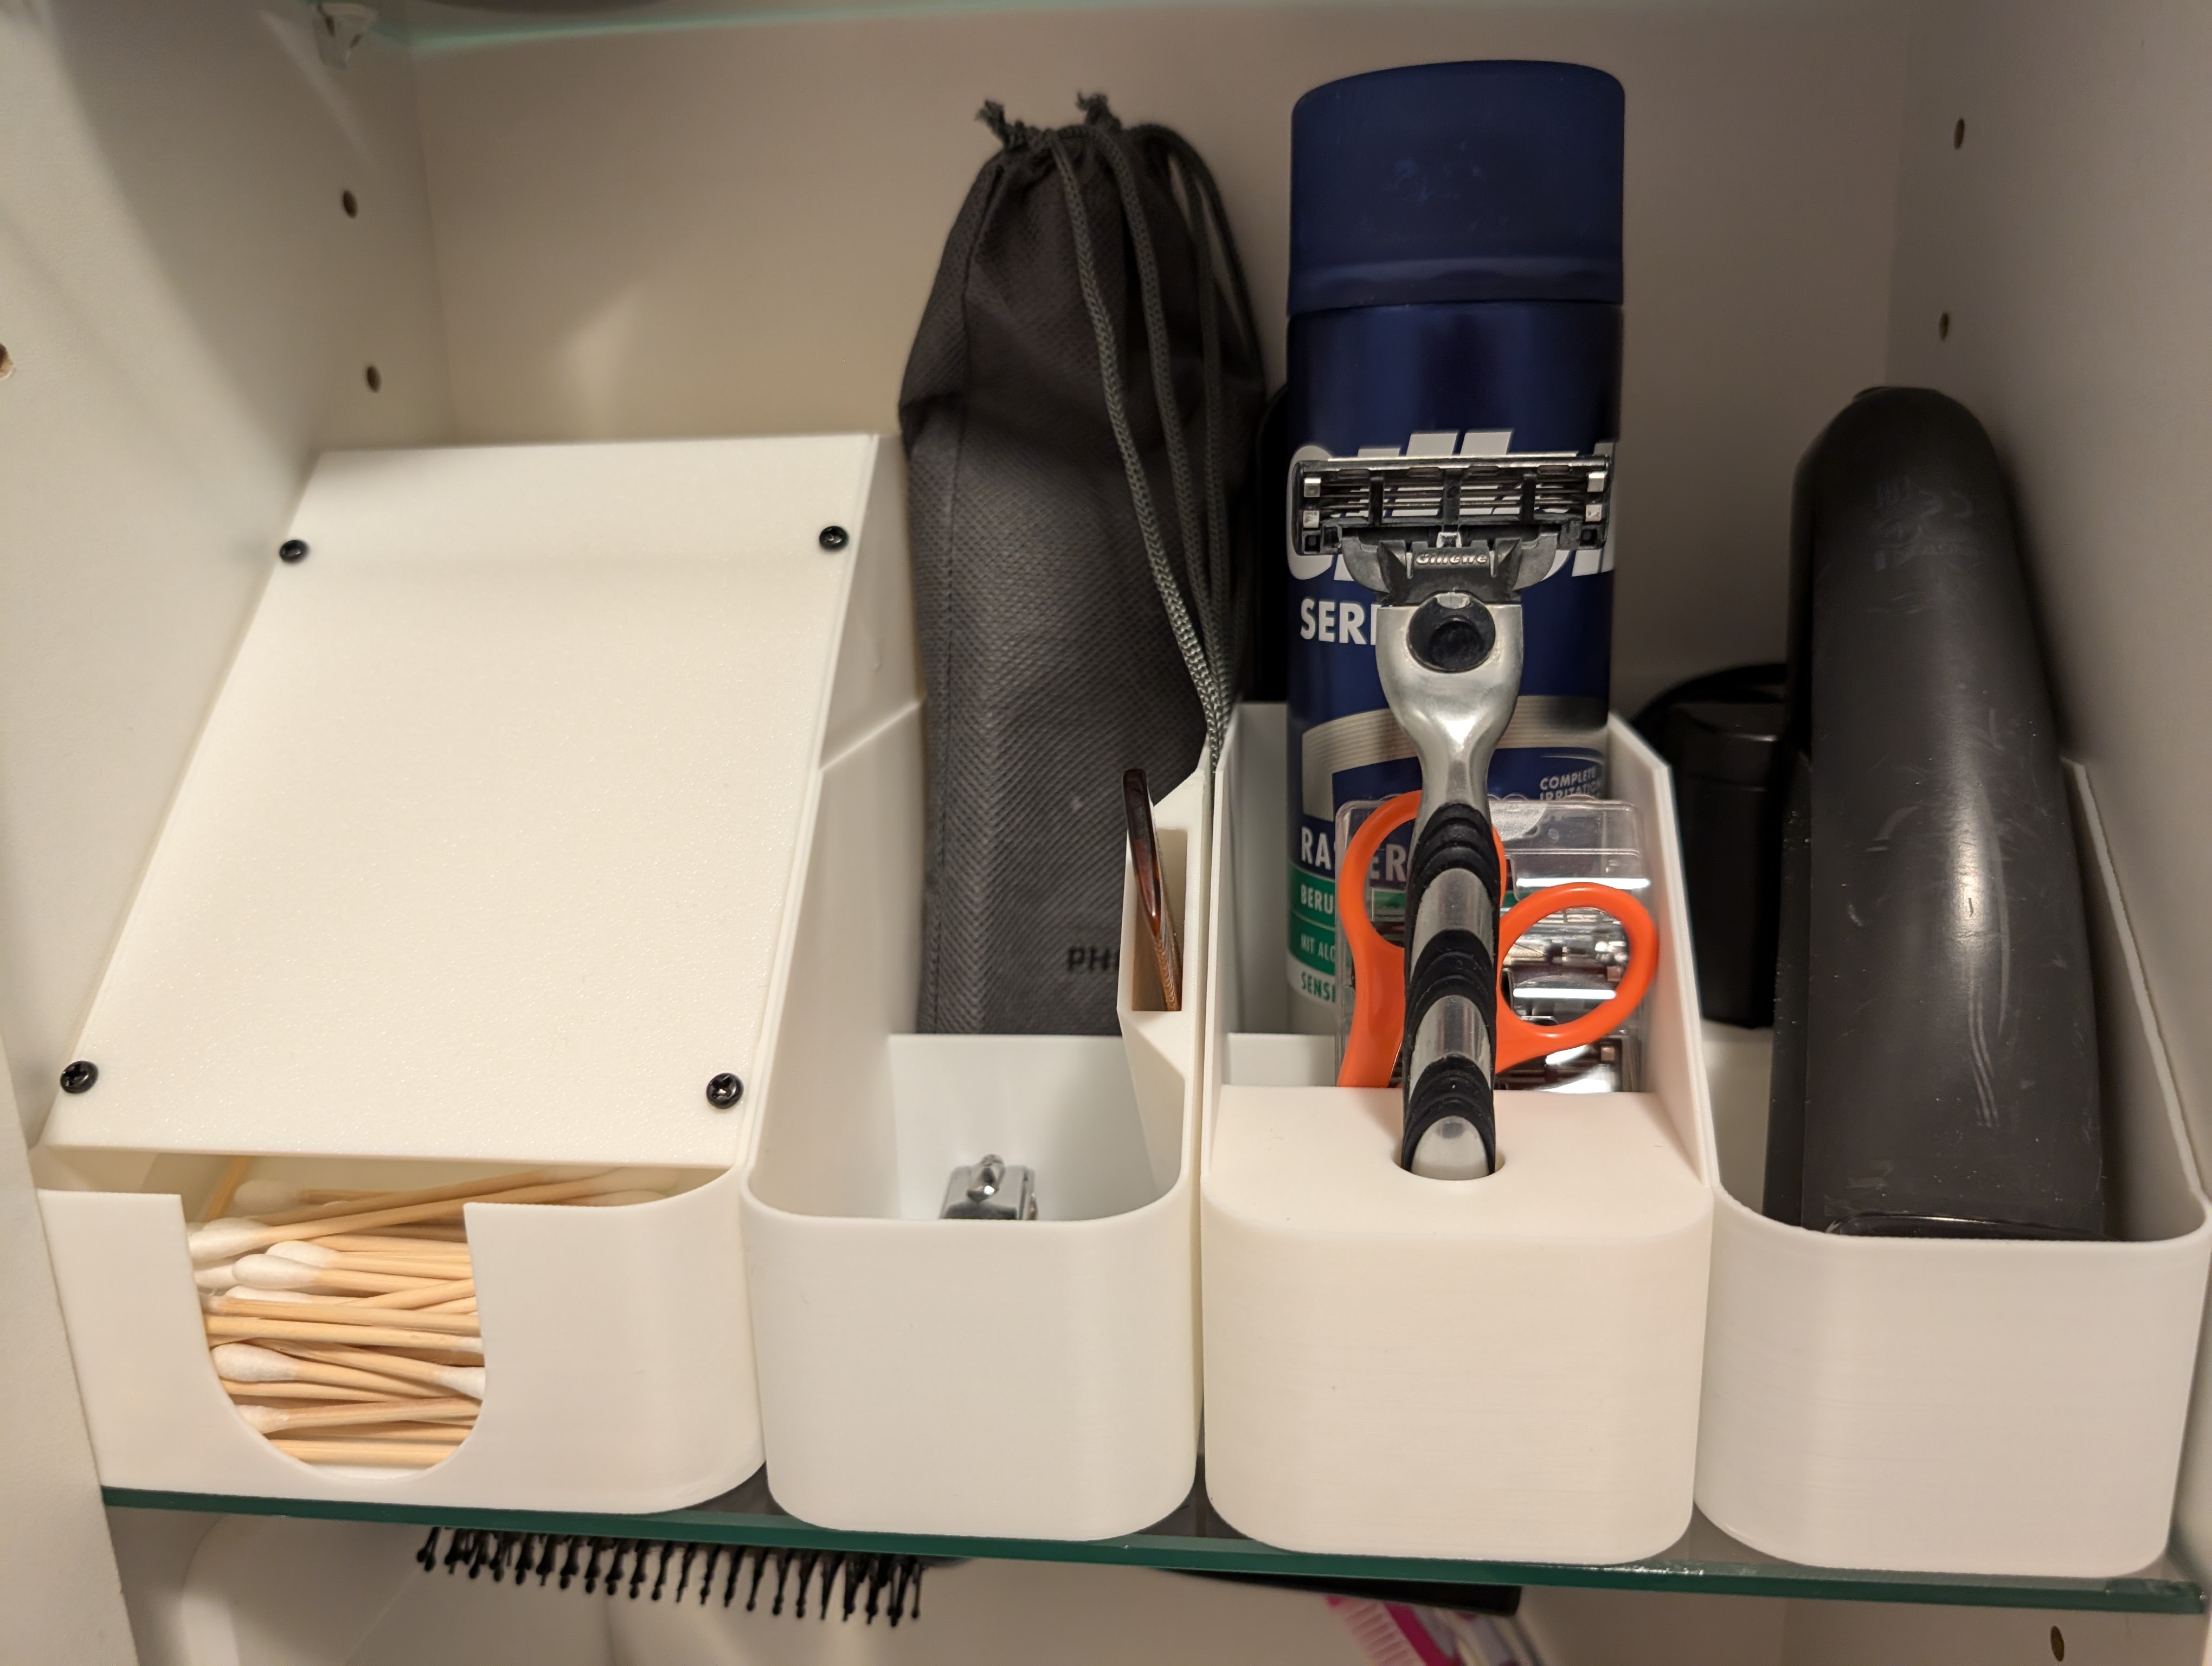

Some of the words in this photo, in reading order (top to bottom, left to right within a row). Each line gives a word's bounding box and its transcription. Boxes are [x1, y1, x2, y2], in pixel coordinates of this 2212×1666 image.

[1415, 552, 1488, 565] Gillette
[1300, 598, 1382, 646] SERI
[1539, 765, 1597, 791] COMPLETE
